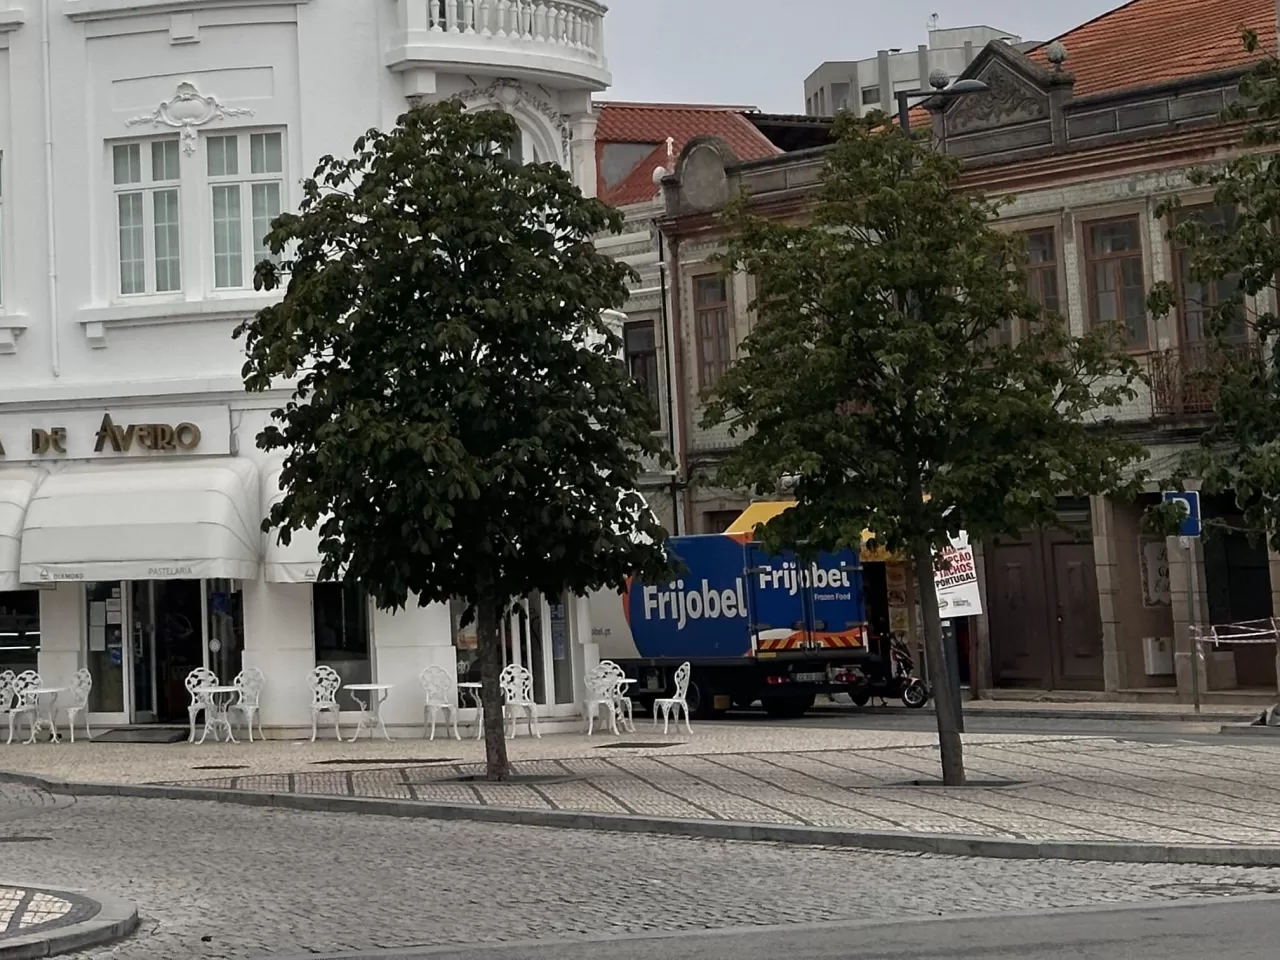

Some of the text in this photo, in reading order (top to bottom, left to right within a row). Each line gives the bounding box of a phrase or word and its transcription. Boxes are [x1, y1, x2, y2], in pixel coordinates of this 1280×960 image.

[148, 567, 192, 576] PASTELARIA
[935, 572, 976, 588] PORTUGAL
[836, 592, 851, 600] Food
[643, 577, 748, 630] Frijobel
